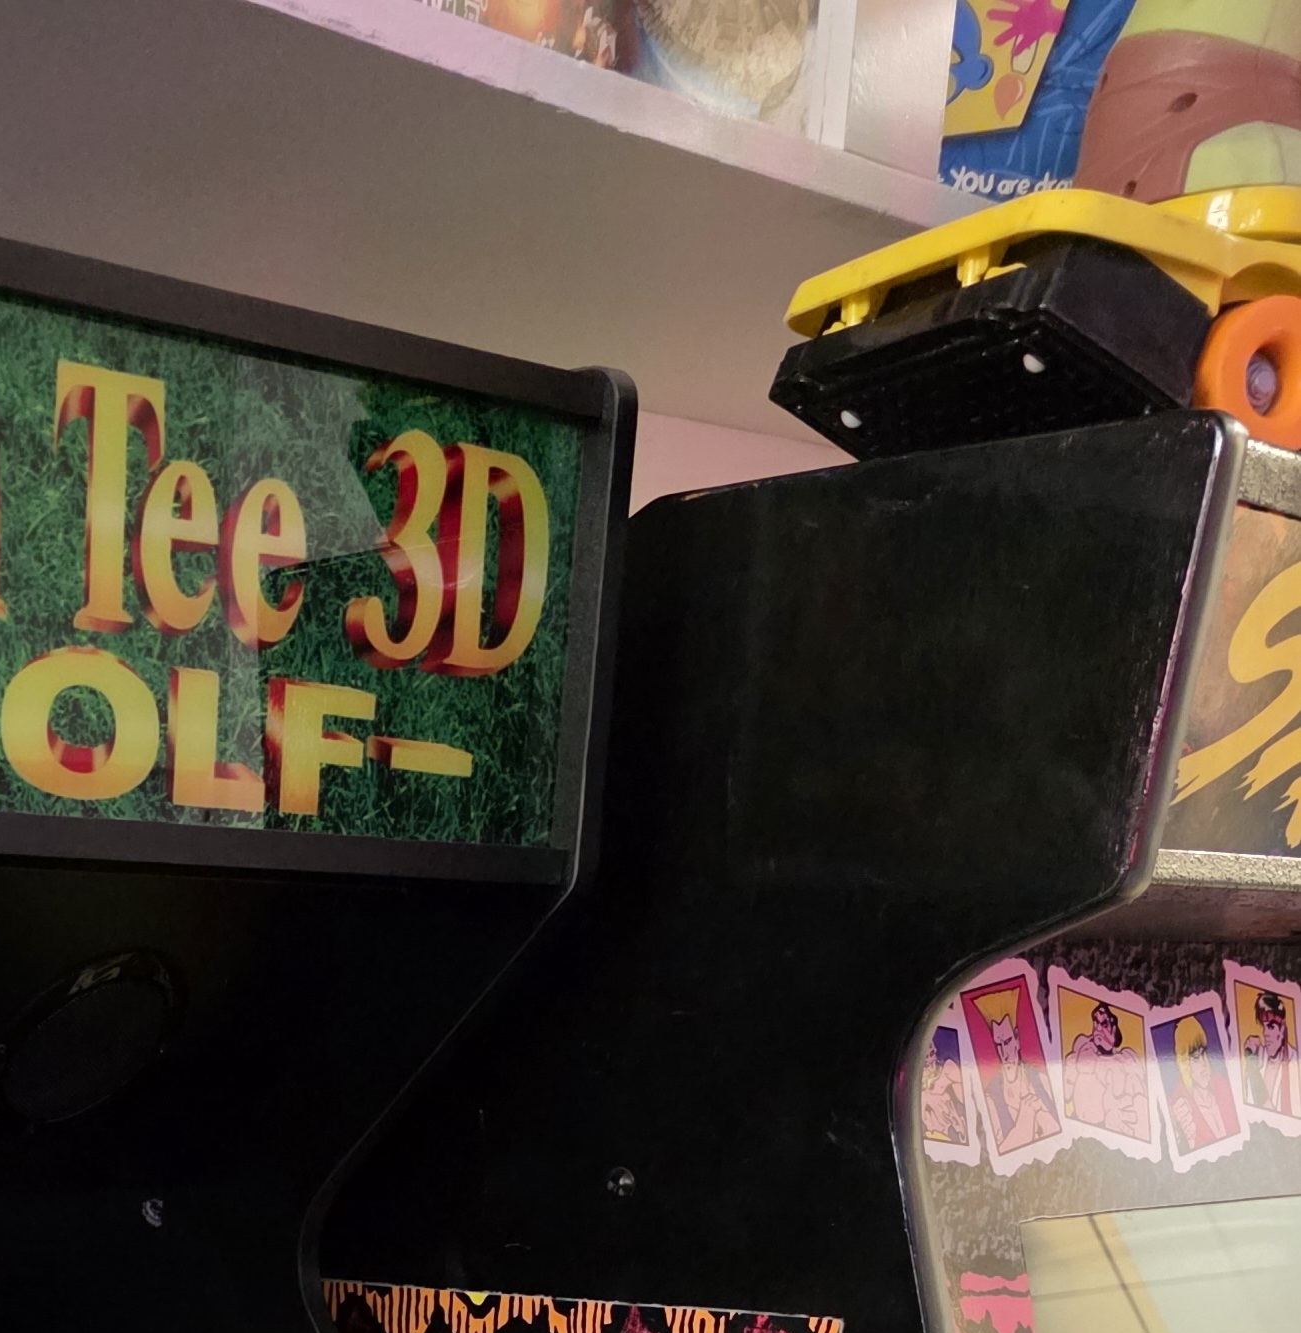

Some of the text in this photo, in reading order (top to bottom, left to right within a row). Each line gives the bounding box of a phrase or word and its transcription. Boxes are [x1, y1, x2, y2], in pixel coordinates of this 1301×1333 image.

[997, 178, 1030, 195] are
[53, 359, 310, 649] Tee
[346, 428, 550, 677] 3D
